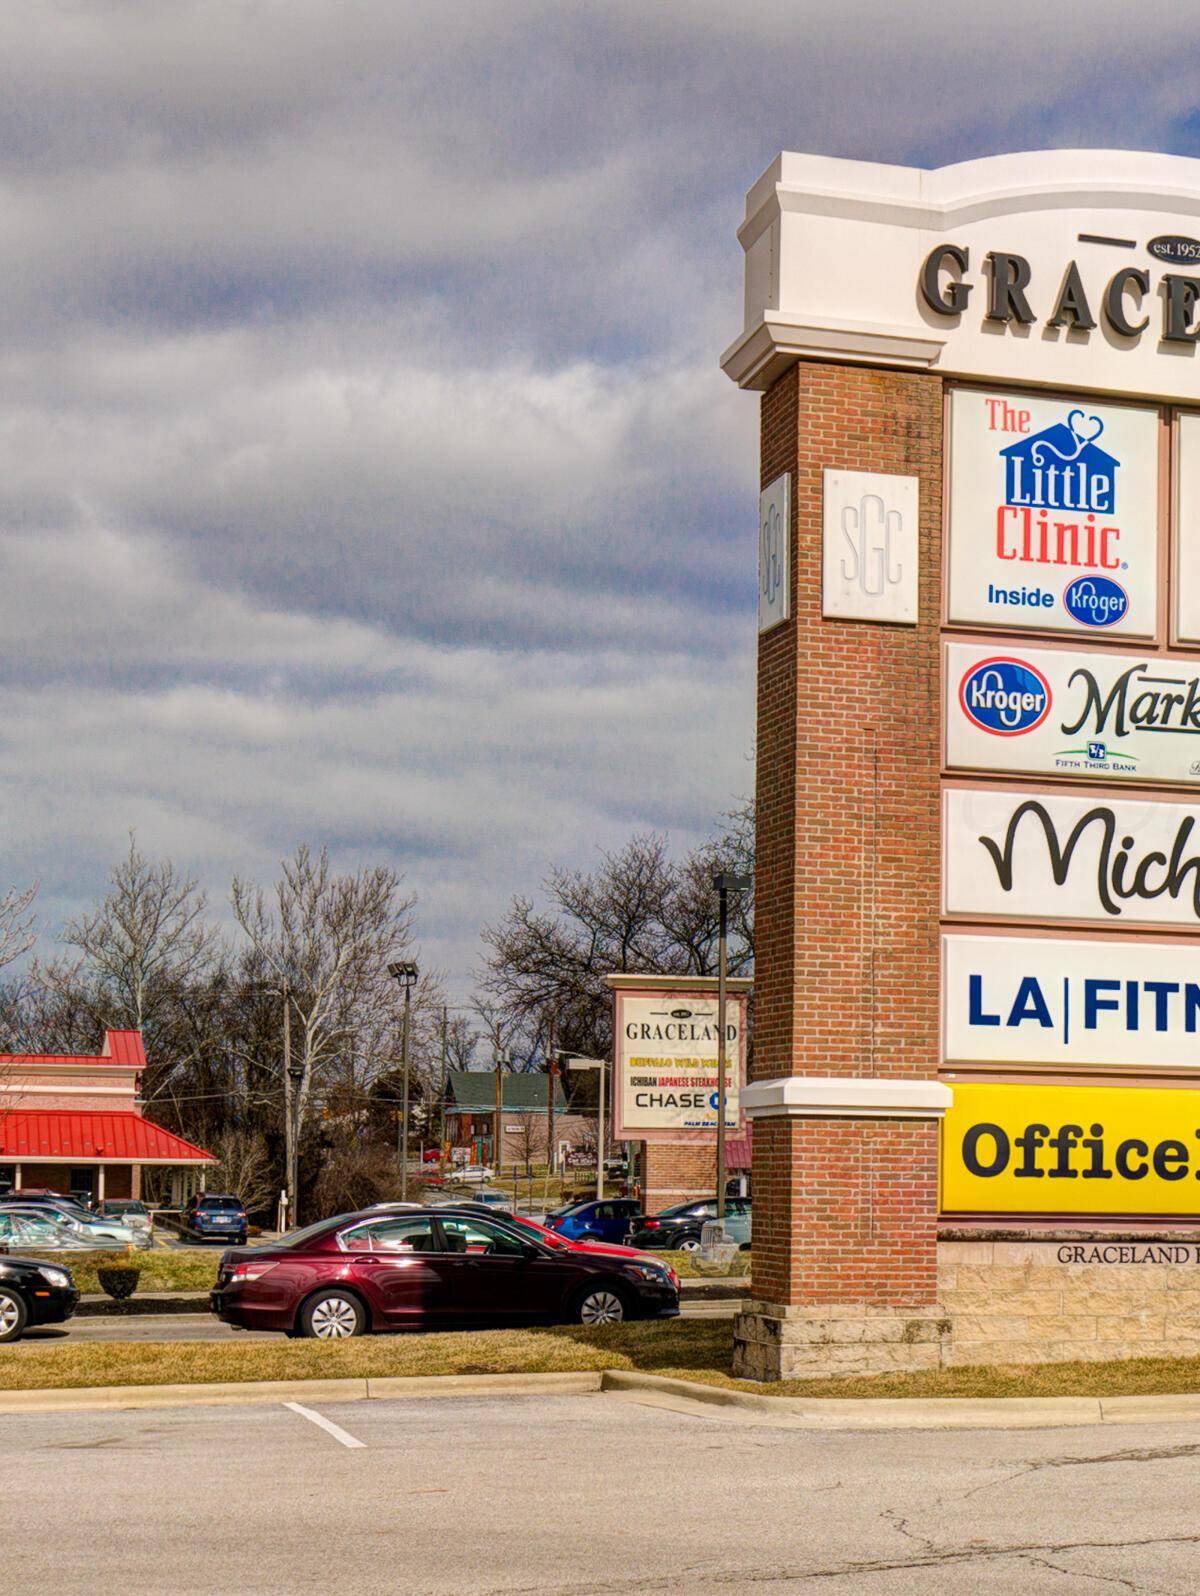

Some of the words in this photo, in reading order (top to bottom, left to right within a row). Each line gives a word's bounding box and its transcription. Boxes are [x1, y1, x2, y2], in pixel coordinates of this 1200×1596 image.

[1153, 243, 1174, 255] est.
[985, 398, 1031, 434] The
[1010, 454, 1110, 512] Little
[996, 505, 1121, 570] Clinic
[988, 584, 1055, 608] Inside
[1071, 581, 1125, 623] Kroger
[971, 670, 1046, 727] Kroger
[1055, 759, 1080, 768] FIFTH
[1083, 761, 1110, 770] THIRD
[1112, 763, 1137, 772] BANK
[968, 974, 1054, 1028] LA
[700, 1058, 732, 1069] WINS
[690, 1077, 732, 1088] STEAKHOSE
[635, 1093, 706, 1108] CHASE
[1057, 1245, 1190, 1265] GRACELAND
